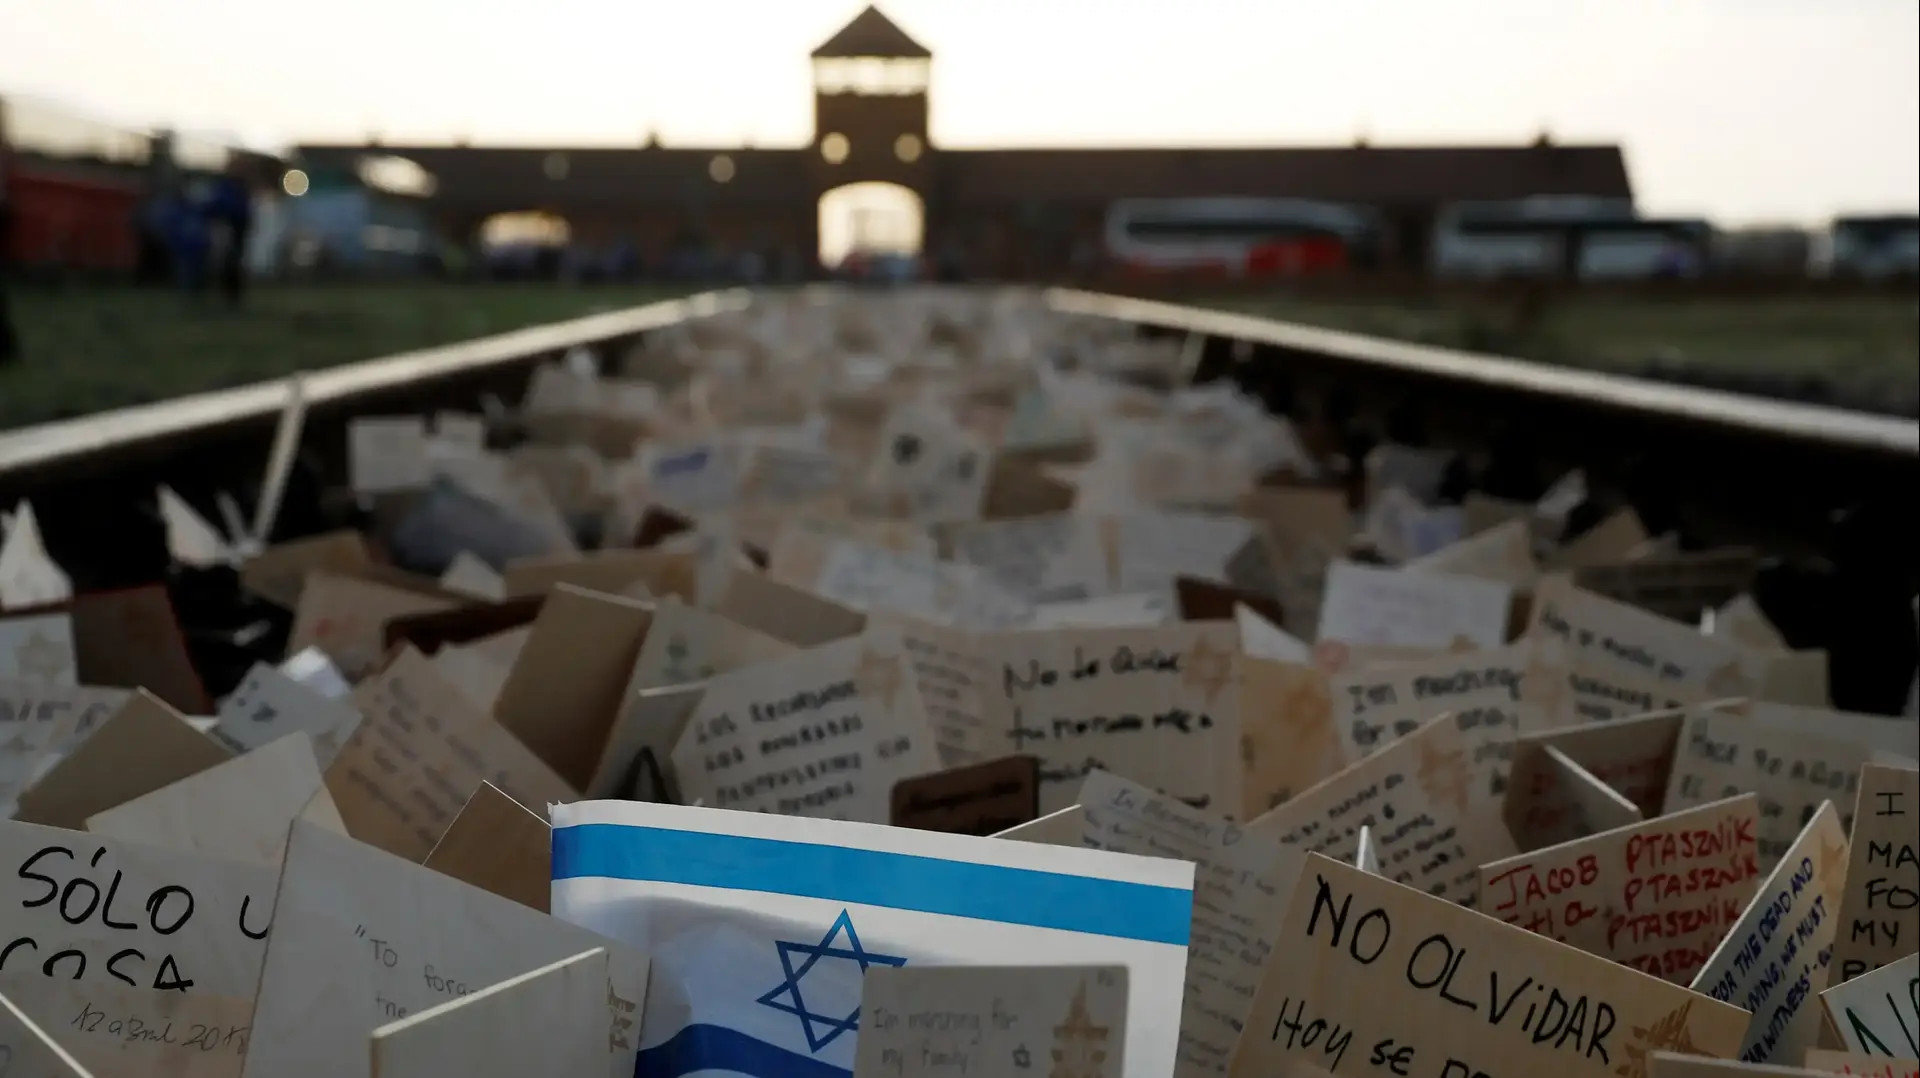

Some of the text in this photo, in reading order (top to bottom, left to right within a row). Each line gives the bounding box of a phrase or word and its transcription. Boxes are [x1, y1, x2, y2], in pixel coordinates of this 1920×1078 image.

[1875, 792, 1905, 816] I
[1866, 839, 1918, 869] MA
[18, 846, 195, 935] SÓLO
[1488, 854, 1600, 911] JACOB
[1864, 877, 1918, 909] FO
[1306, 874, 1391, 965] NO
[1733, 933, 1762, 977] THE
[1758, 890, 1793, 943] DEAD
[1790, 857, 1813, 899] AND
[1851, 919, 1900, 947] MY
[70, 1001, 105, 1033] 12
